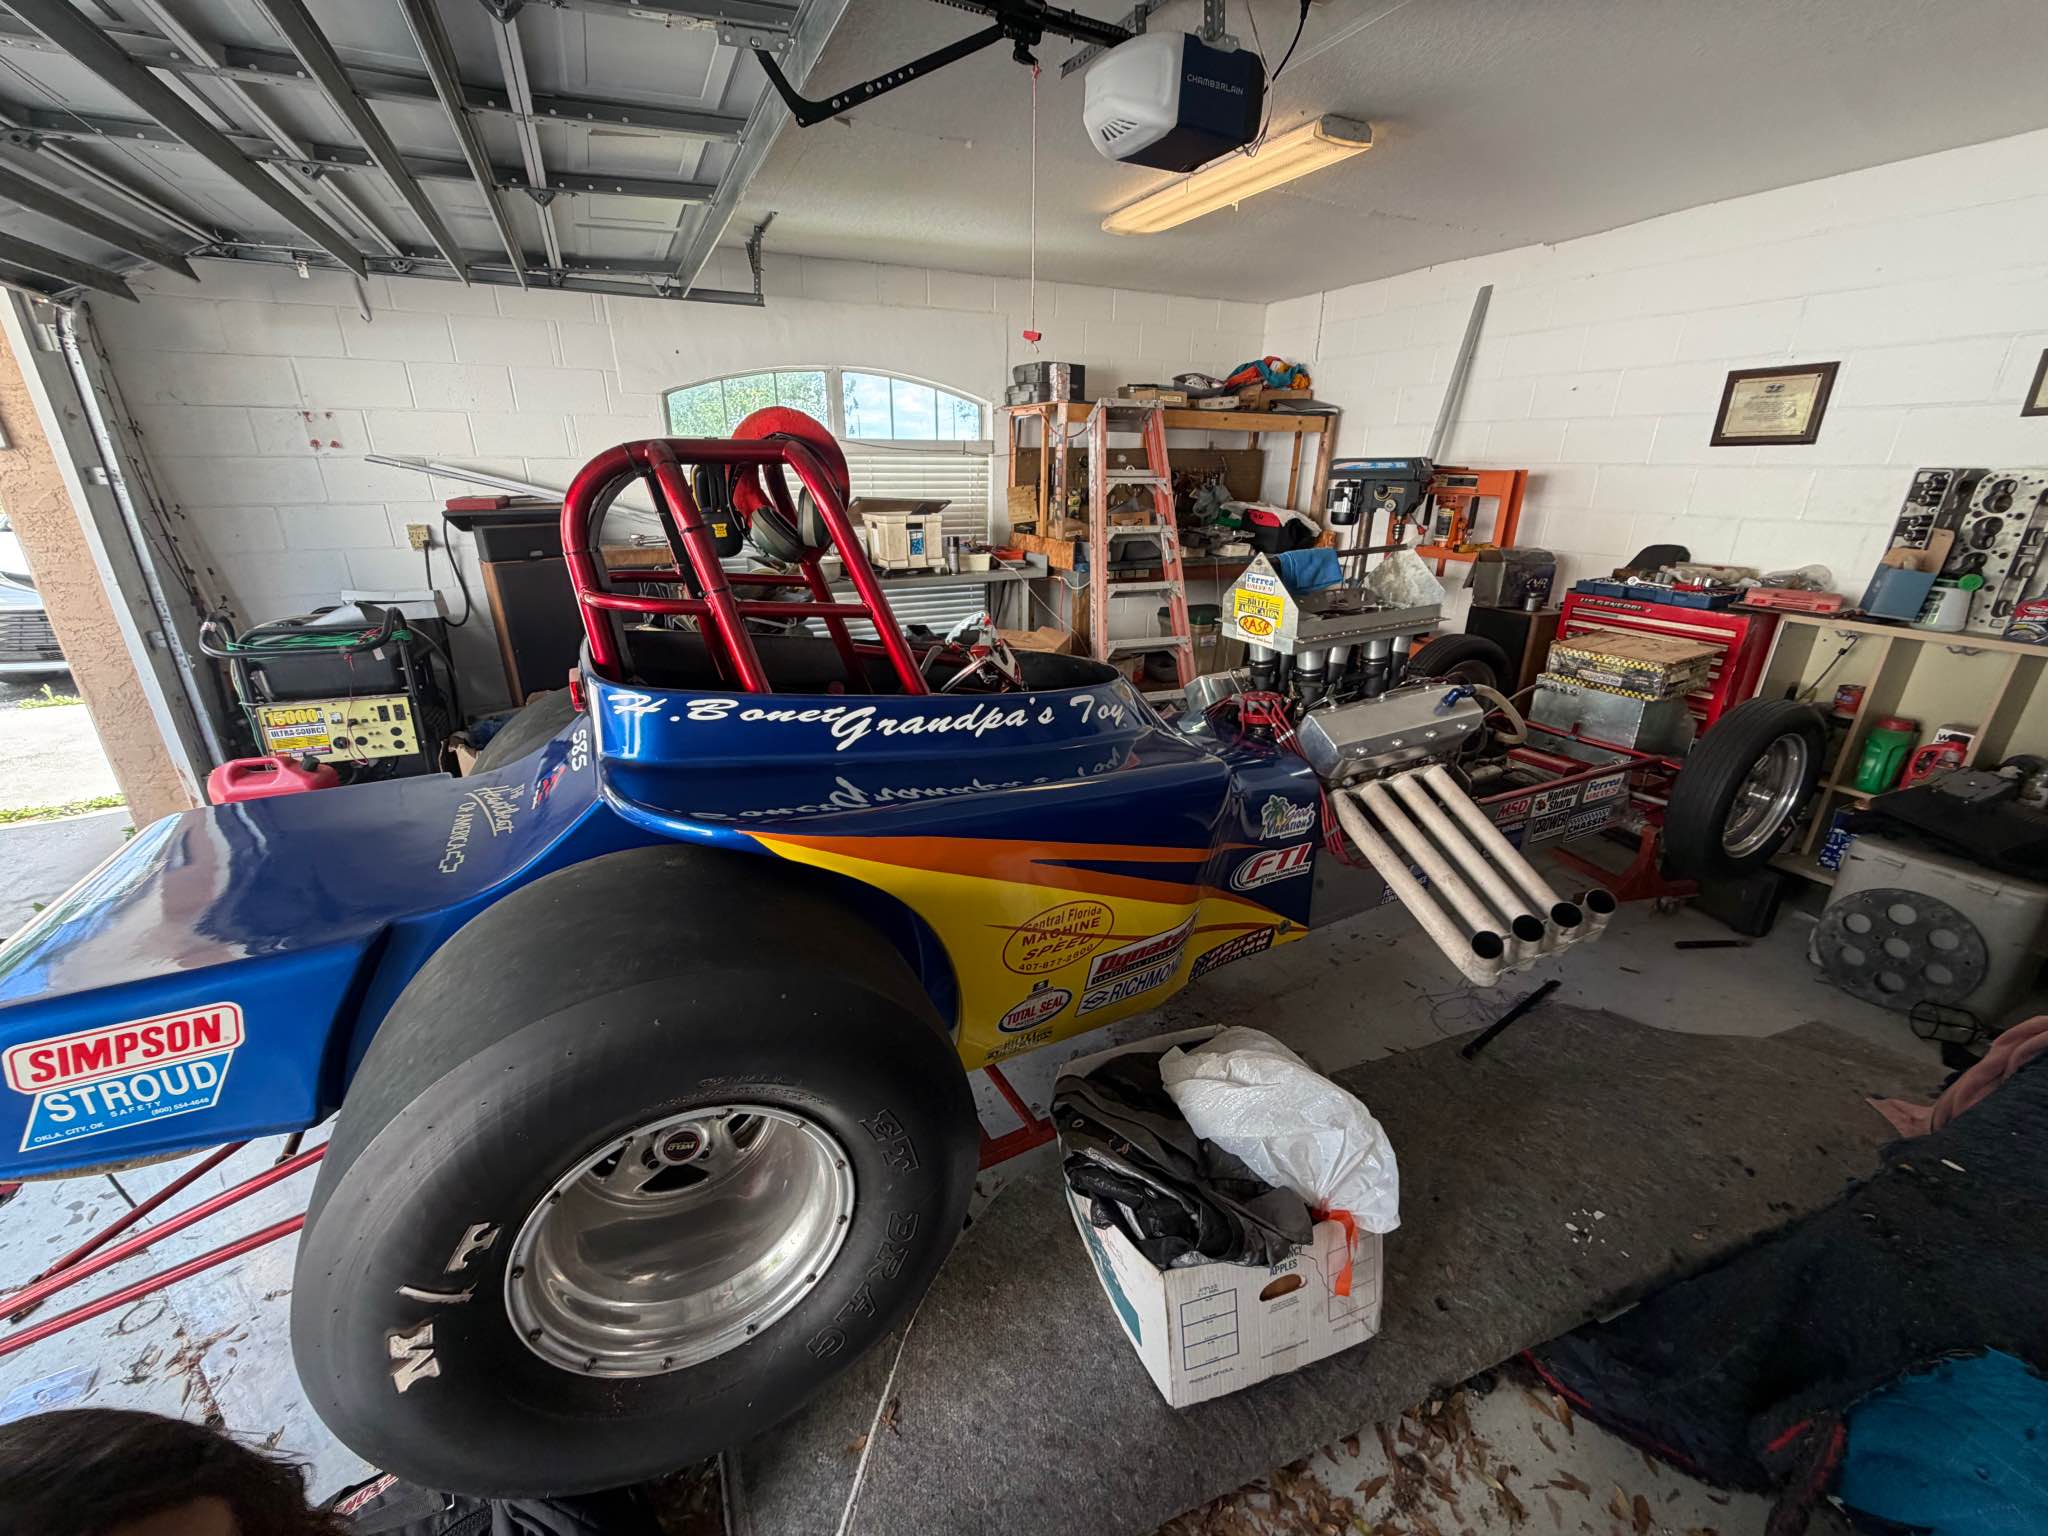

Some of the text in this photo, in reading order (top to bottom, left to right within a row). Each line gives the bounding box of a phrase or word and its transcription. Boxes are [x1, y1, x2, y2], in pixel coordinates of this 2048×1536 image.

[1186, 73, 1244, 96] CHAMBERLAIN
[265, 708, 319, 727] 15000
[829, 696, 1055, 751] Grandpa's
[1068, 906, 1102, 922] Florida
[1022, 917, 1101, 947] MACHINE
[1022, 933, 1096, 961] SPEED
[1007, 1005, 1037, 1026] TOTAL
[1040, 996, 1064, 1013] SEAL
[28, 1013, 221, 1083] SIMPSON
[43, 1060, 218, 1122] STROUD
[110, 1100, 161, 1118] SAFETY
[89, 1121, 105, 1131] OK
[1269, 1259, 1298, 1277] APPLES
